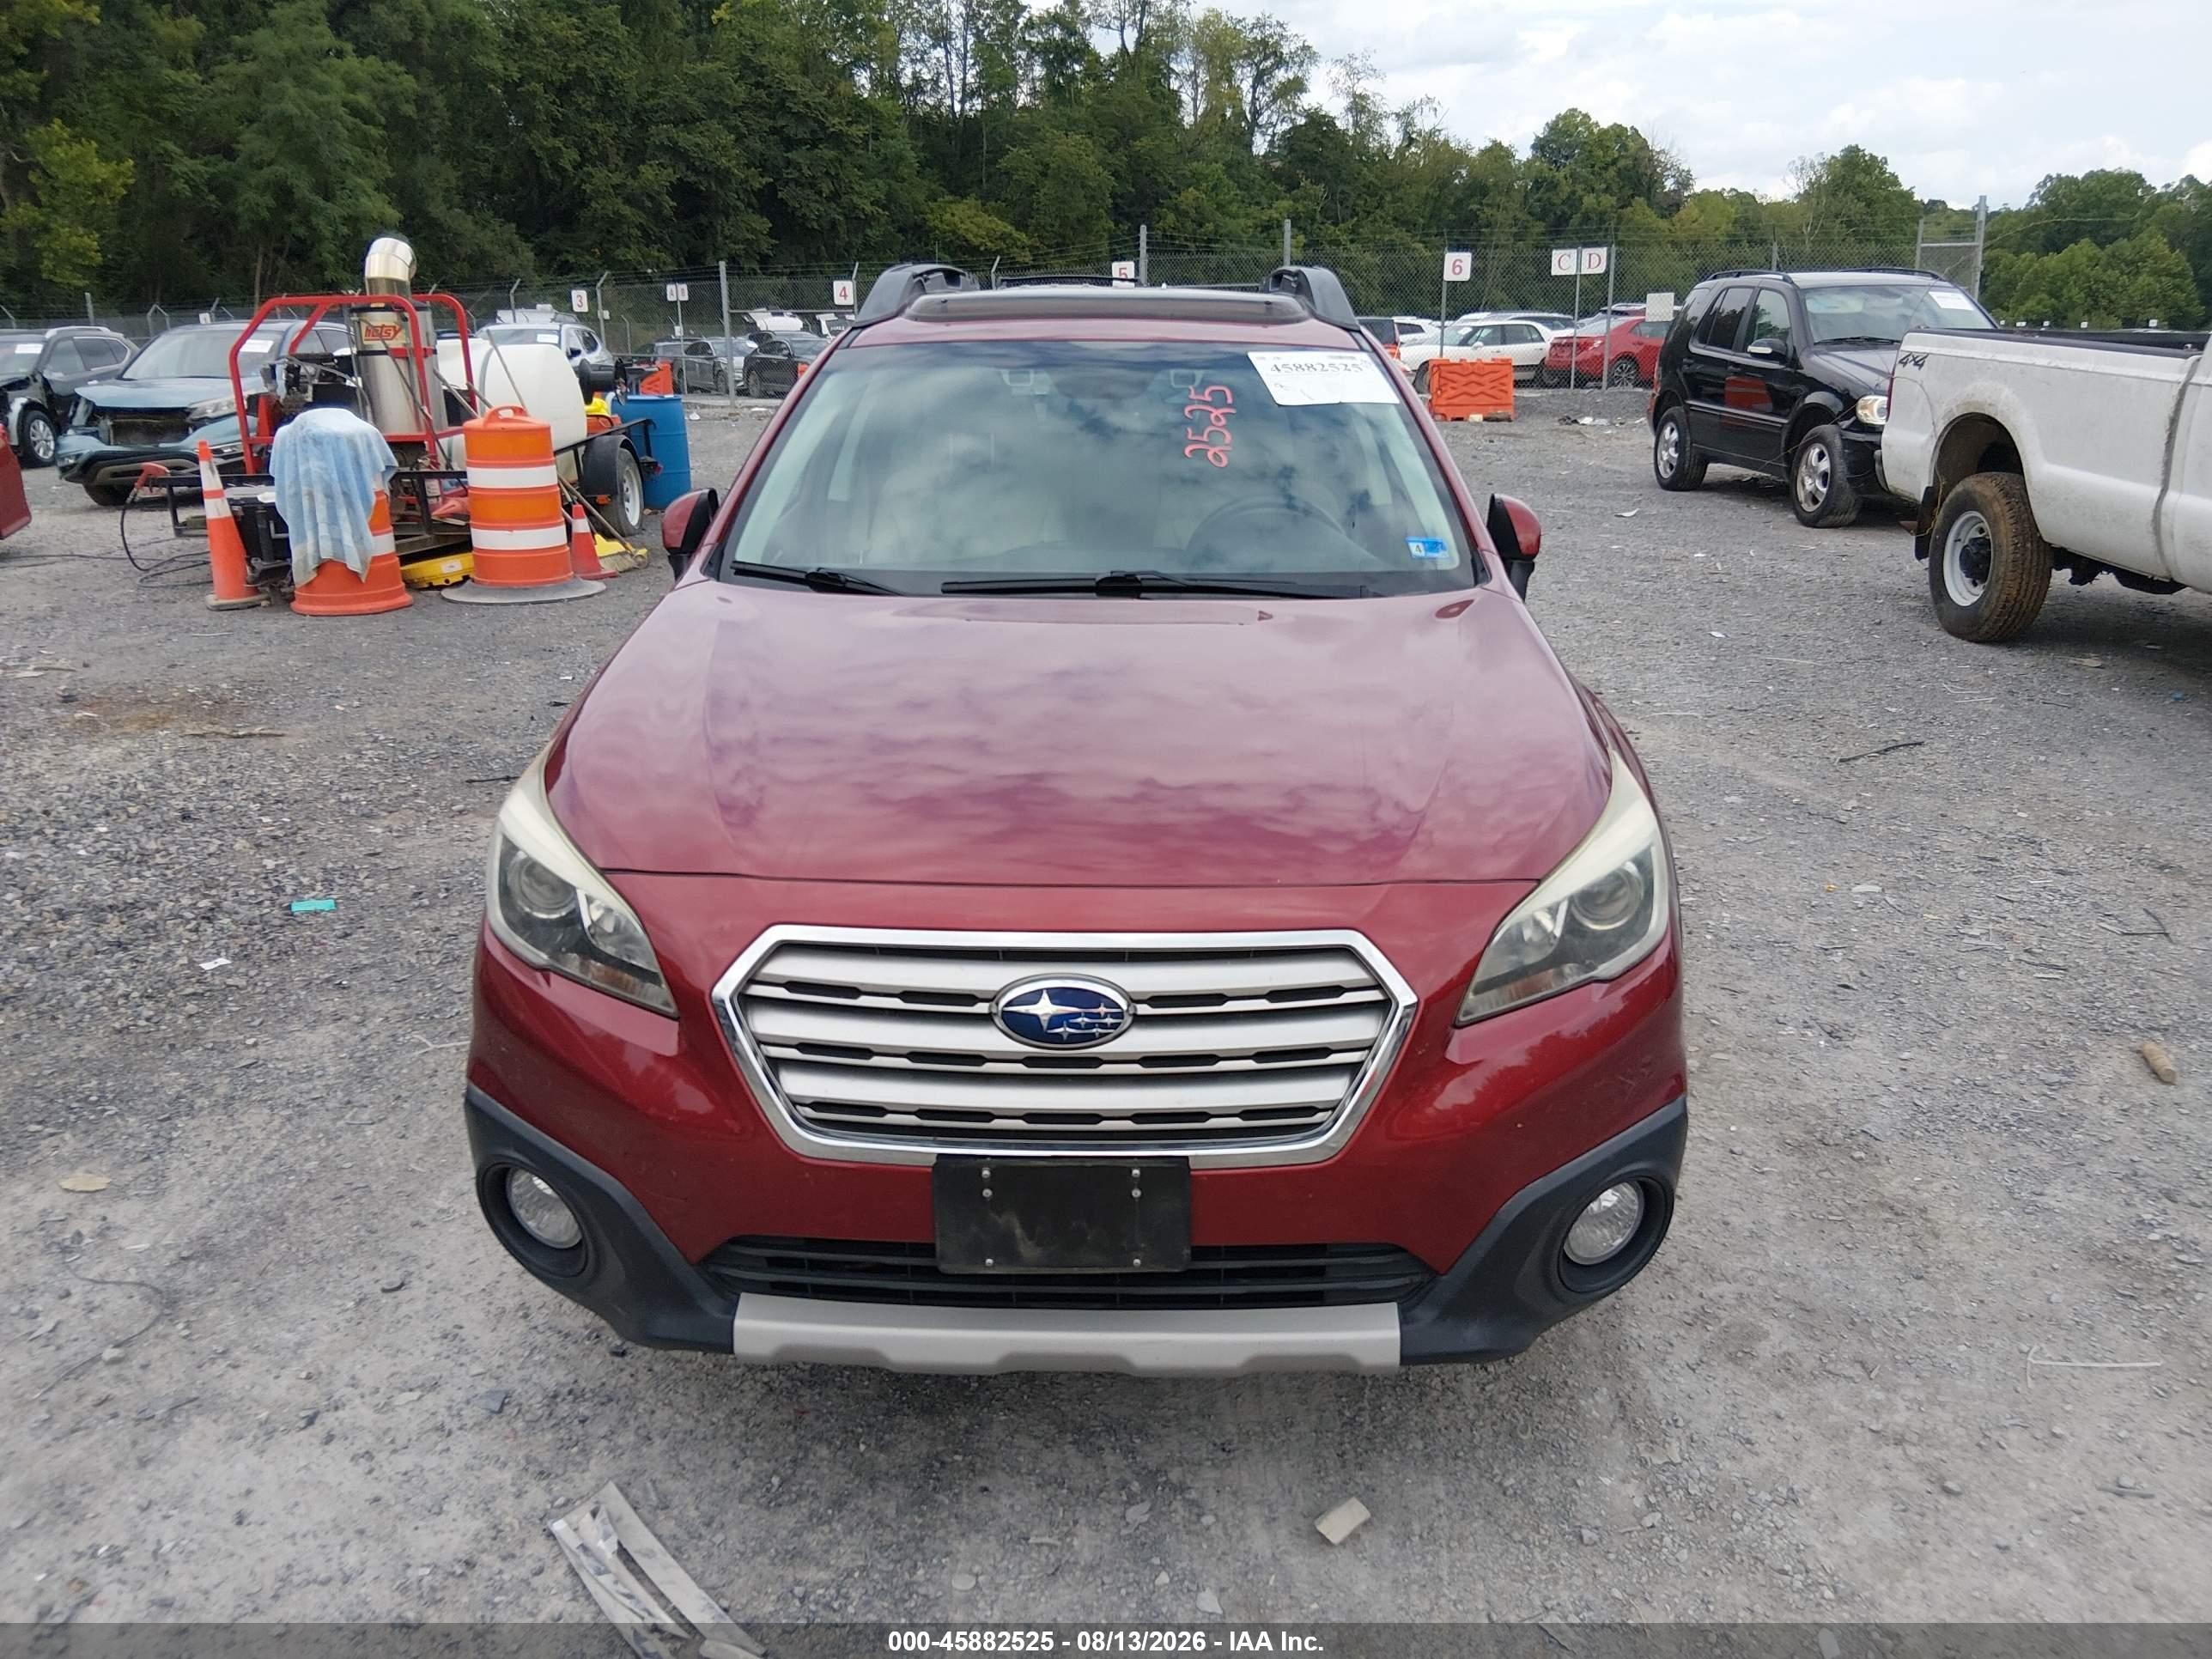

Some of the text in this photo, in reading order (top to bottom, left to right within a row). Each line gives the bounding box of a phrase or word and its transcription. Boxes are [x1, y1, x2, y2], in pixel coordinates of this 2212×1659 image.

[1451, 258, 1464, 276] 6
[1557, 253, 1572, 271] C
[1587, 252, 1602, 270] D
[1118, 267, 1128, 279] 5
[575, 294, 584, 308] 3
[839, 286, 848, 301] 4
[1270, 362, 1364, 374] 45882525
[1184, 385, 1237, 468] 2525
